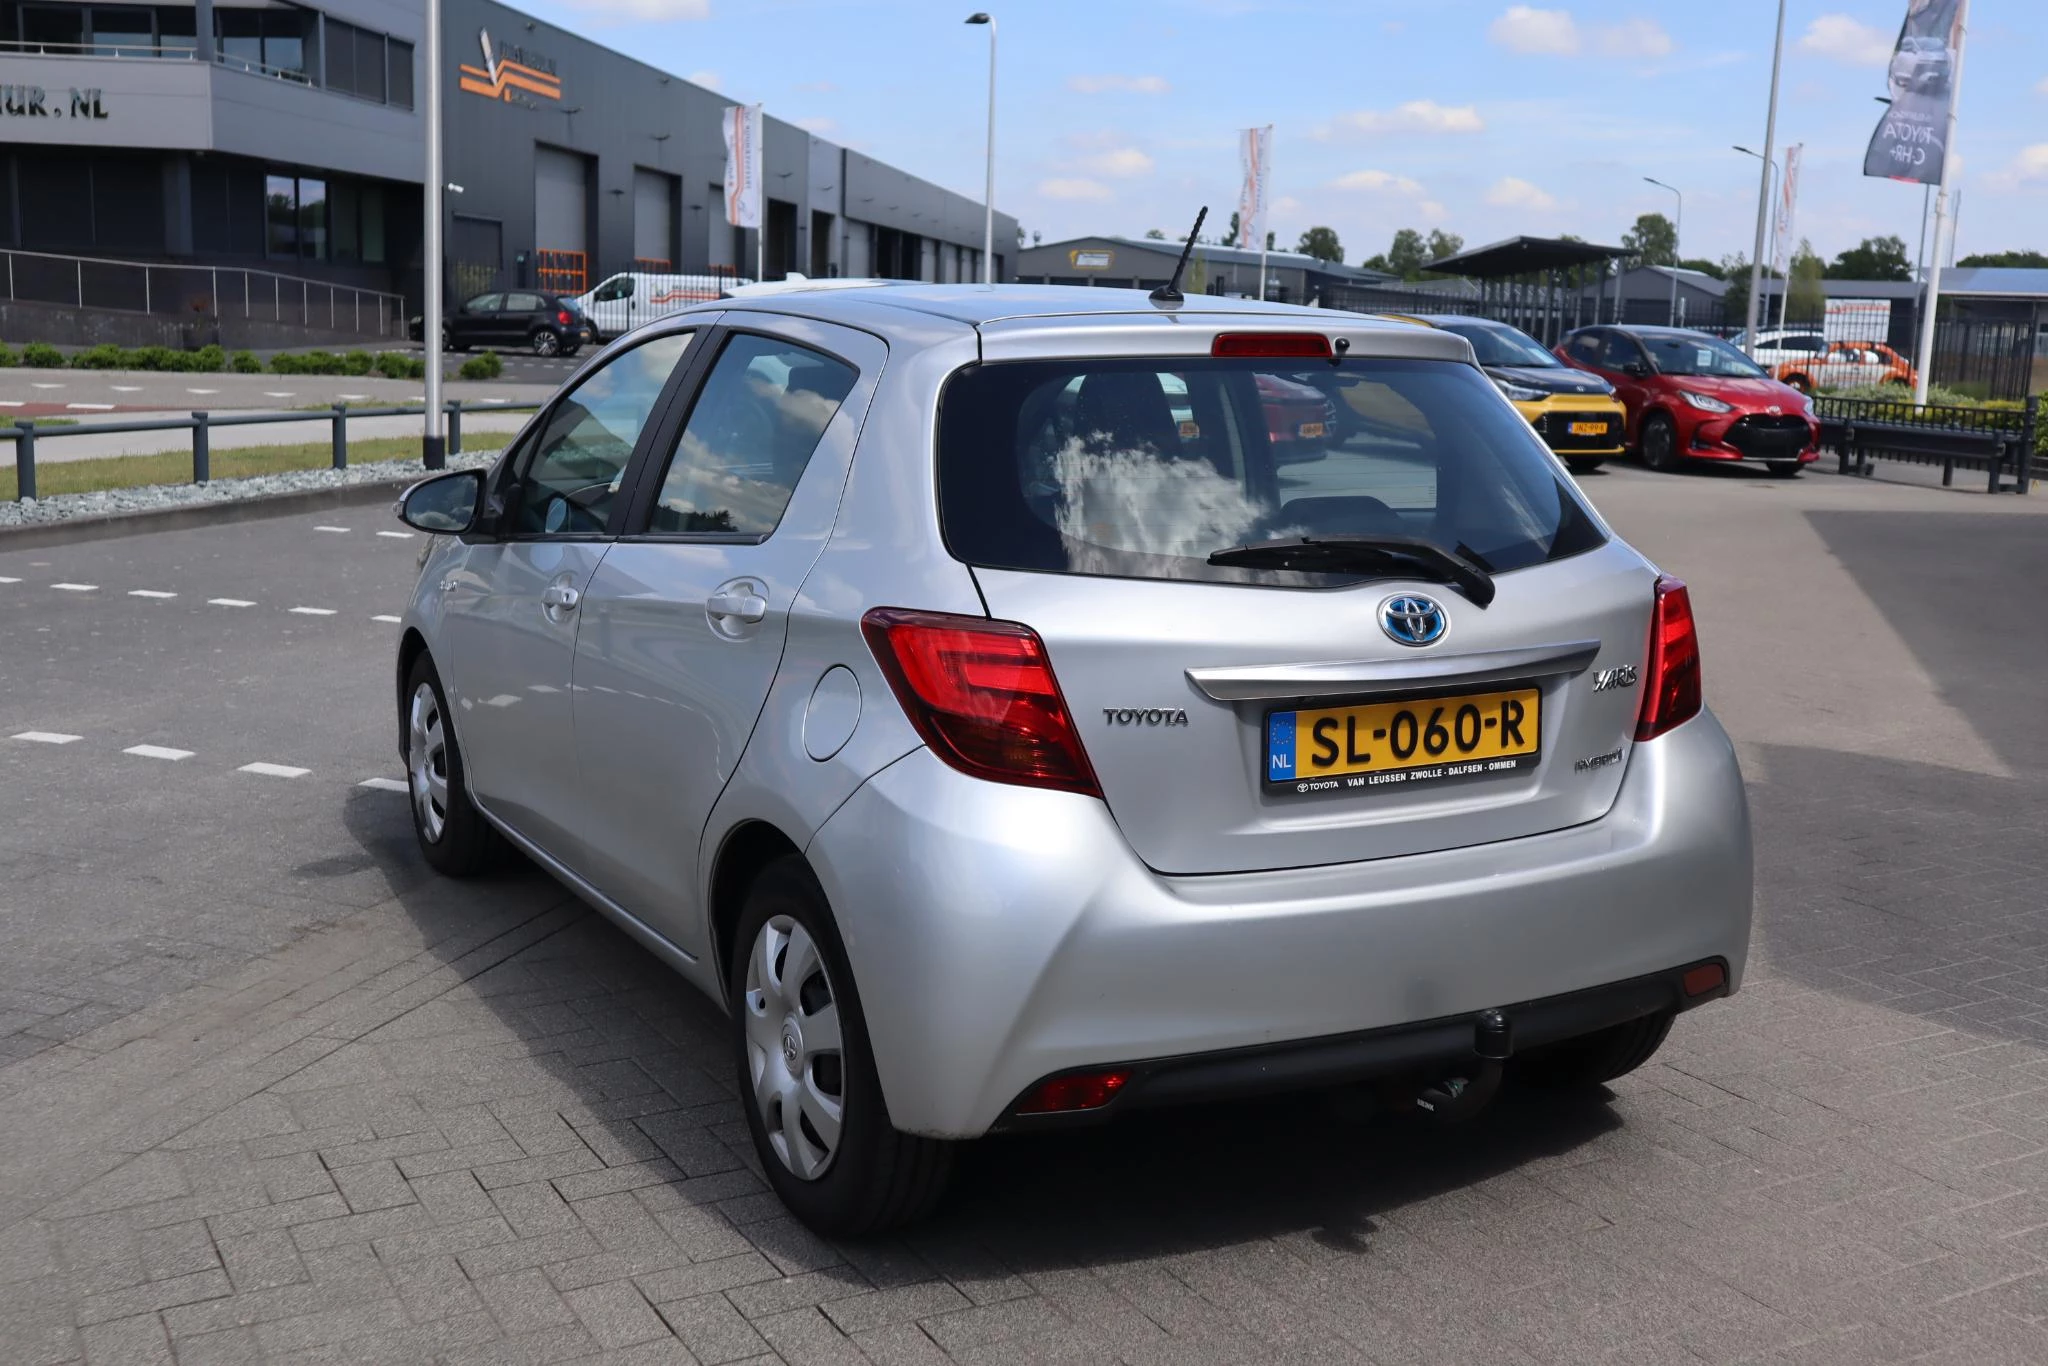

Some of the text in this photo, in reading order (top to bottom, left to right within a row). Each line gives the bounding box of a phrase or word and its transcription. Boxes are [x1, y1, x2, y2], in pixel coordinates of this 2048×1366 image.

[1103, 707, 1189, 727] TOYOTA
[1311, 700, 1525, 767] SL-060-R
[1271, 754, 1291, 769] NL
[1347, 776, 1365, 787] VAN
[1368, 773, 1407, 786] LEUSSEN
[1410, 769, 1442, 781] ZWOLLE
[1448, 764, 1483, 776] DALFSEN
[1488, 759, 1517, 772] OMMEN
[1309, 780, 1339, 791] TOYOTA
